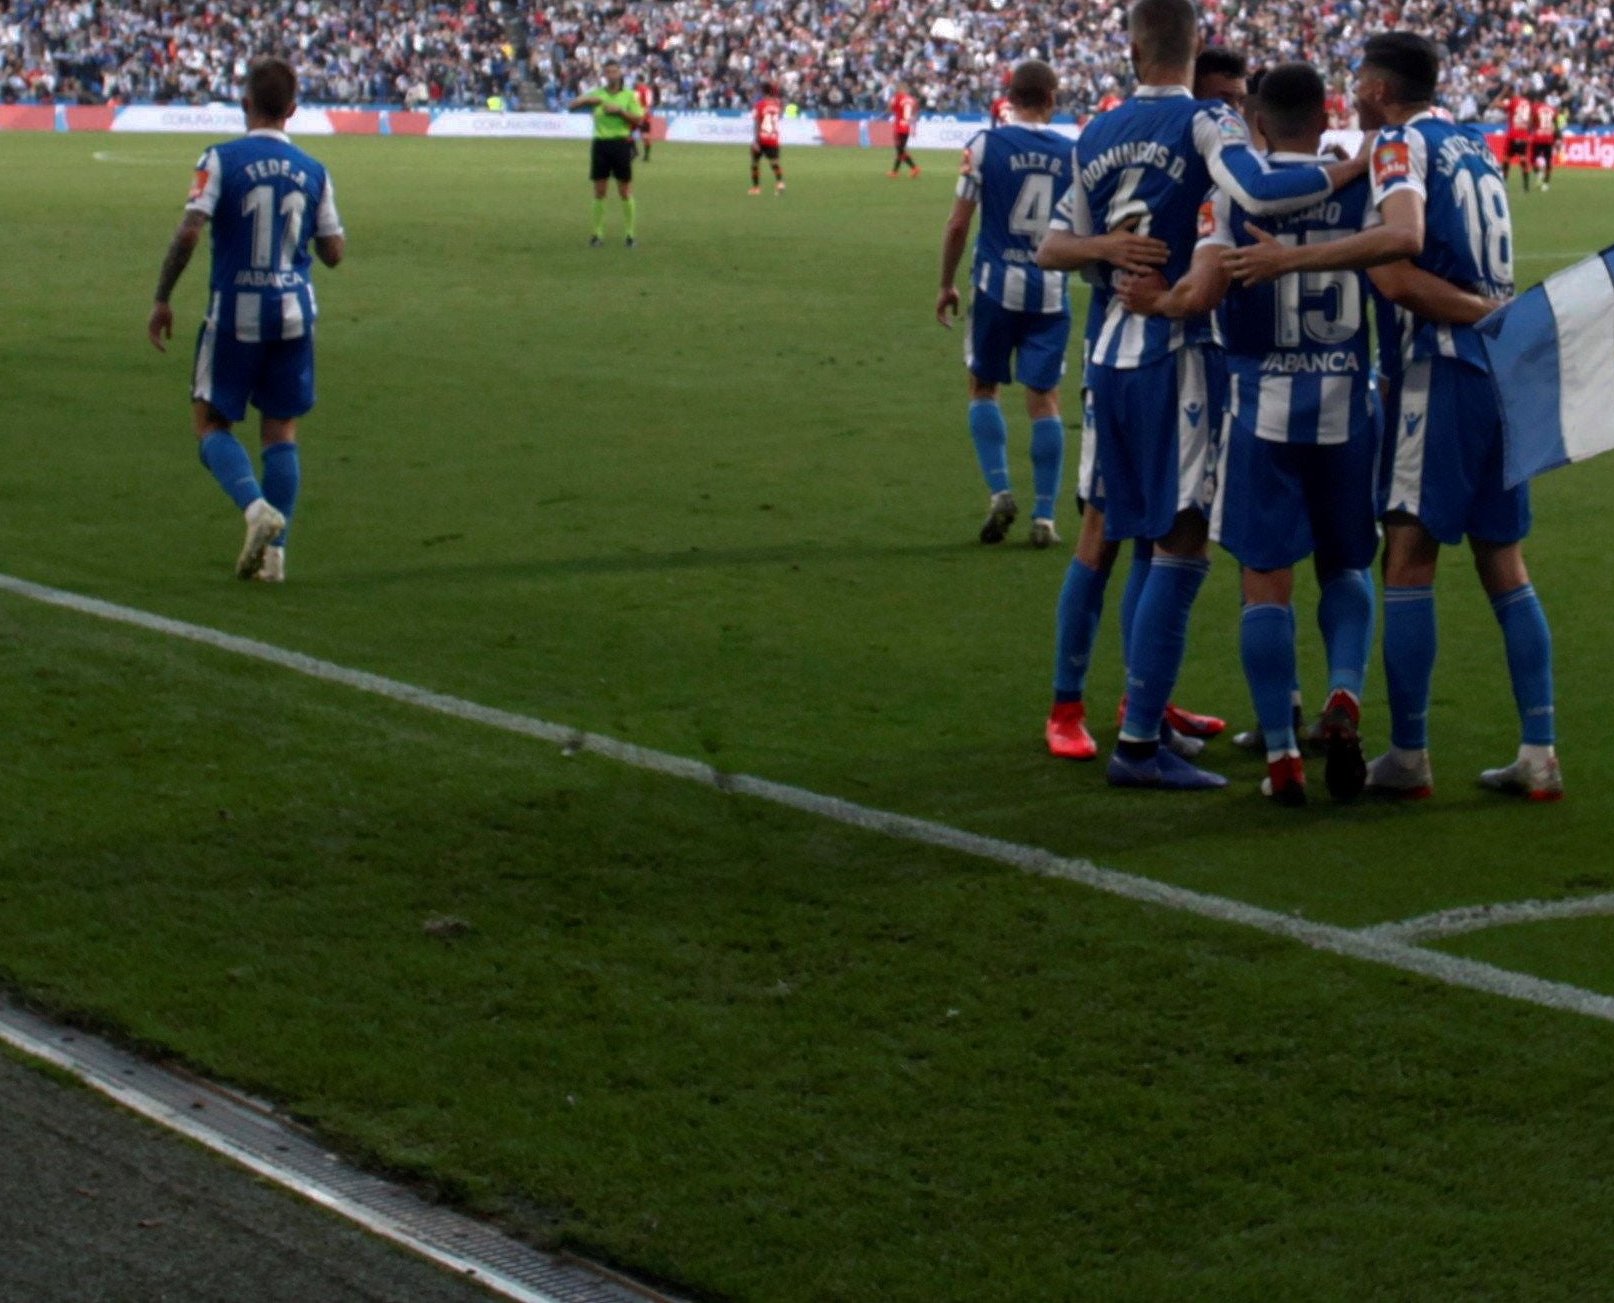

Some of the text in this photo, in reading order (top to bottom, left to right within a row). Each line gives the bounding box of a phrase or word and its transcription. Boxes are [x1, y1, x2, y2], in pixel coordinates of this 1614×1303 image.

[242, 184, 306, 272] 11
[1008, 174, 1054, 250] 4
[1453, 168, 1514, 284] 18
[1274, 228, 1361, 348] 15
[1267, 351, 1360, 373] ABANCA
